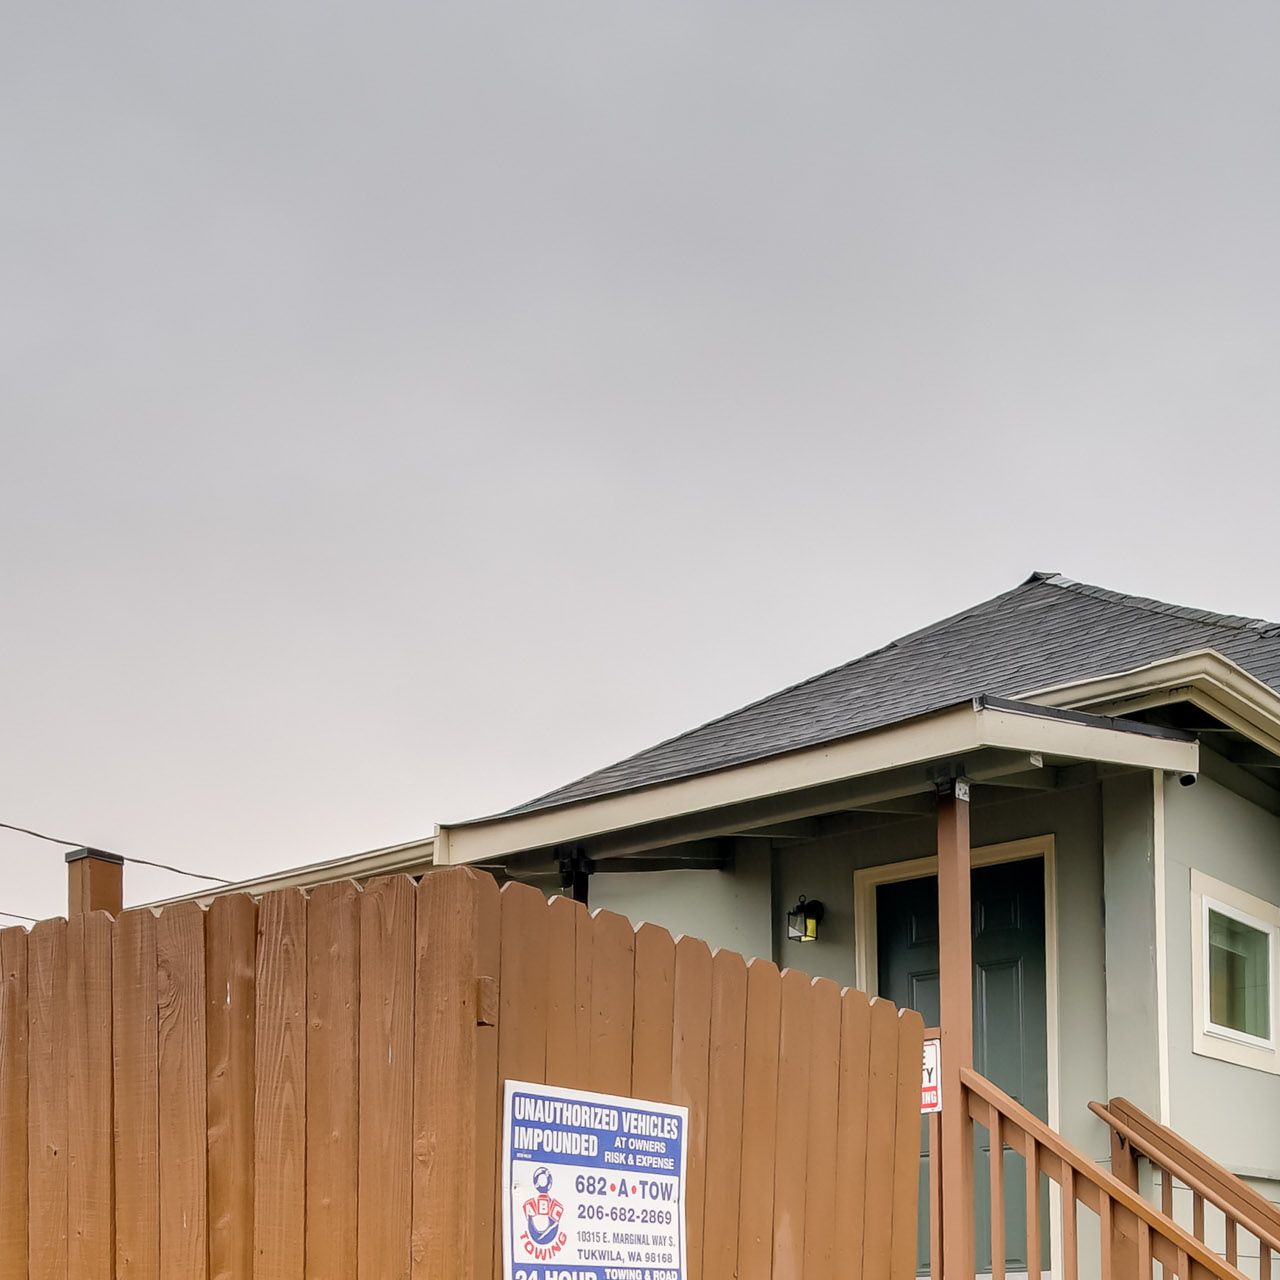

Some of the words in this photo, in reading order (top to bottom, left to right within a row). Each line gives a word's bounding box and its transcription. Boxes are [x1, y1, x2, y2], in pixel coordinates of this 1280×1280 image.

[514, 1096, 619, 1131] UNAUTHORIZED
[621, 1111, 679, 1139] VEHICLES
[514, 1126, 598, 1156] IMPOUNDED
[614, 1137, 627, 1148] AT
[628, 1138, 666, 1153] OWNERS
[604, 1151, 626, 1165] RISK
[627, 1154, 634, 1166] &
[635, 1154, 675, 1170] EXPENSE
[524, 1198, 564, 1220] ABC
[577, 1204, 672, 1225] 206-682-2869
[520, 1231, 567, 1260] TOWING
[577, 1231, 600, 1243] 10315
[602, 1232, 610, 1243] E.
[612, 1232, 650, 1246] MARGINAL
[652, 1235, 667, 1246] WAY
[577, 1249, 625, 1263] TUKWILA,
[627, 1251, 642, 1262] WA
[644, 1252, 673, 1263] 98168
[604, 1268, 642, 1280] TOWING
[644, 1270, 652, 1280] &
